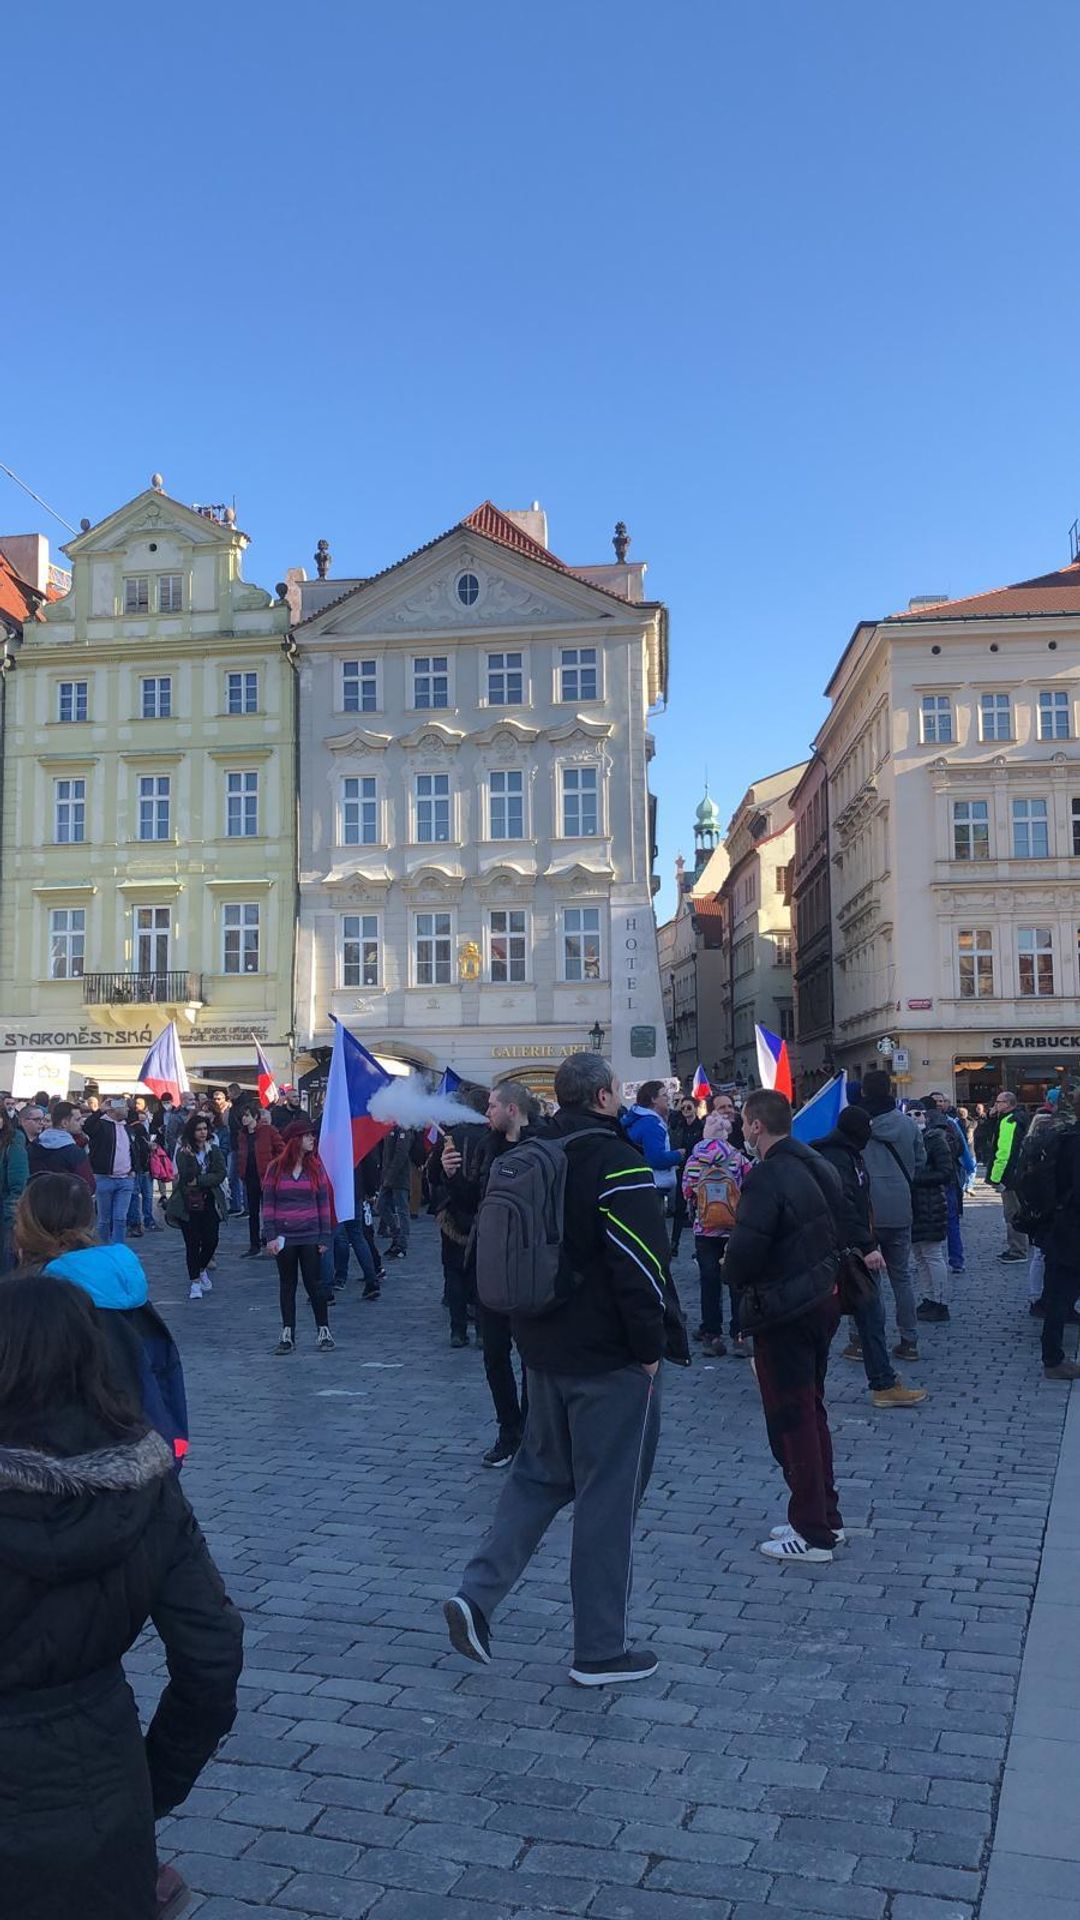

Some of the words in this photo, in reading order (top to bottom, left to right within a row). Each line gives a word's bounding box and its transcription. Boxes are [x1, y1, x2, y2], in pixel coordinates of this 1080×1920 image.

[625, 918, 638, 1010] HOTEL
[4, 1024, 153, 1047] STAROMĚSTSKÁ
[491, 1045, 555, 1057] GALERIE
